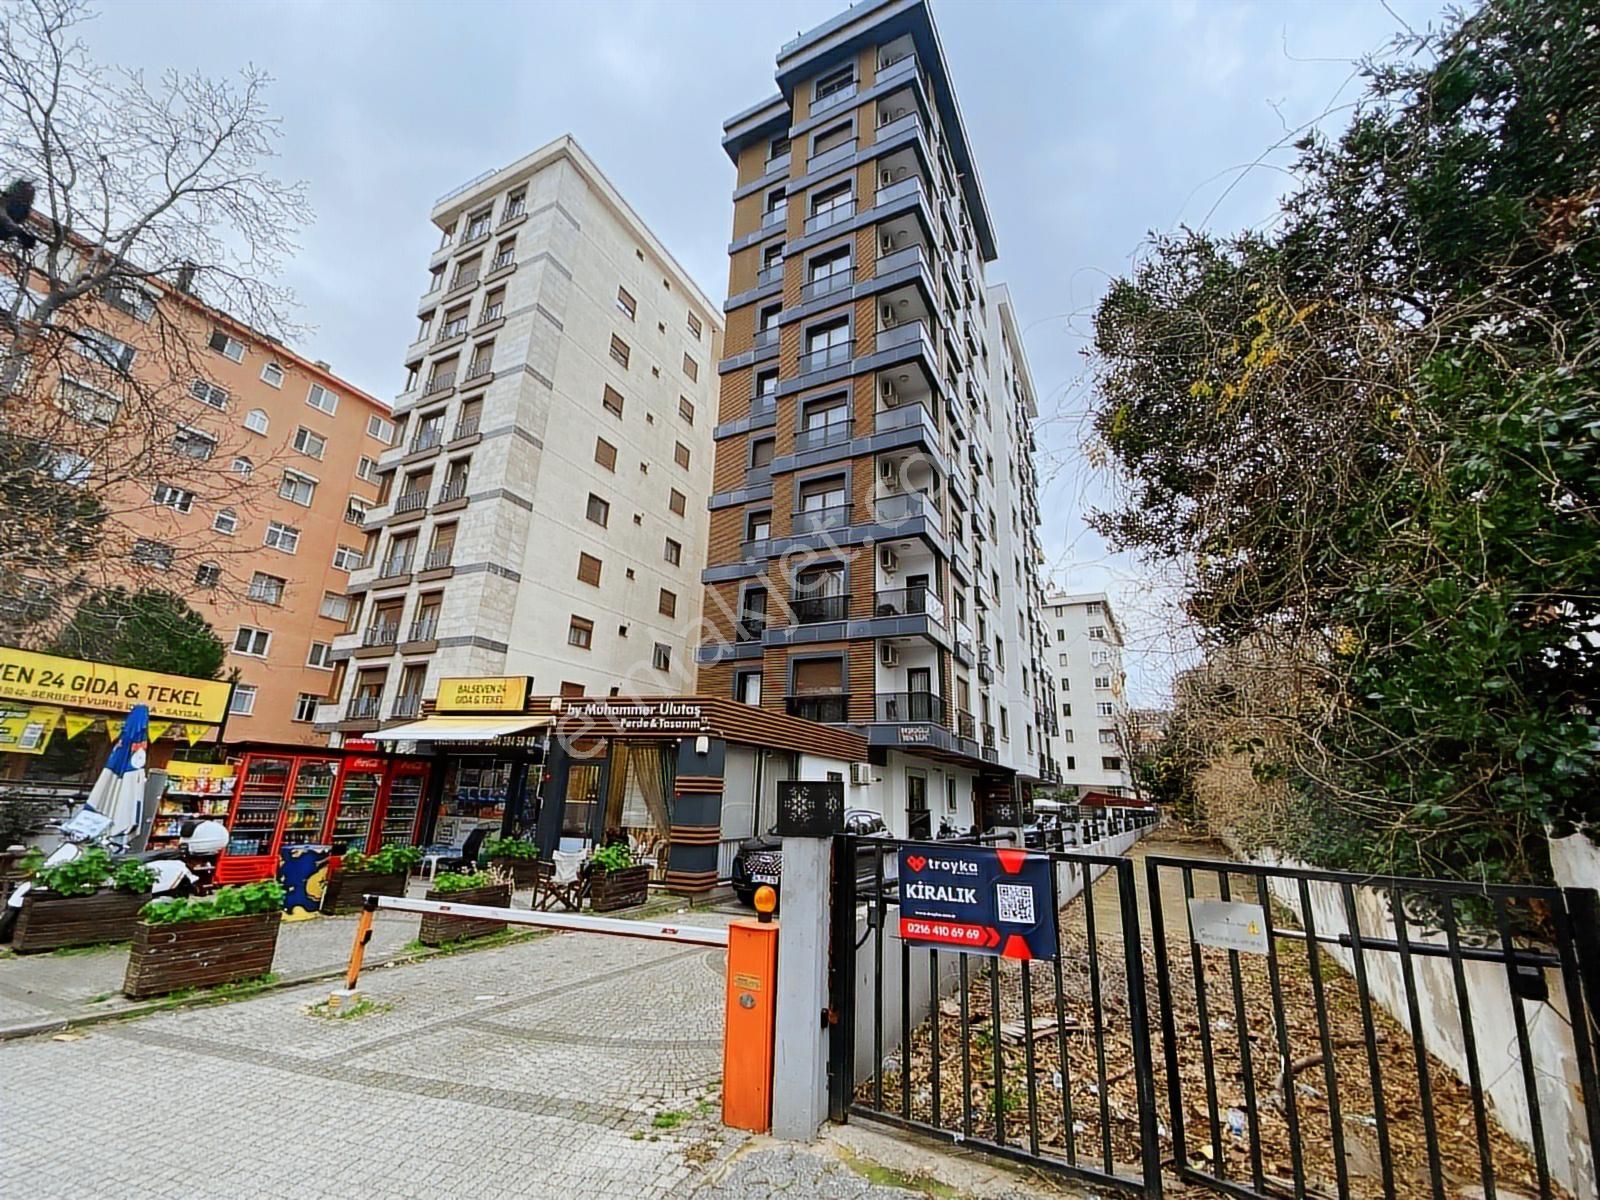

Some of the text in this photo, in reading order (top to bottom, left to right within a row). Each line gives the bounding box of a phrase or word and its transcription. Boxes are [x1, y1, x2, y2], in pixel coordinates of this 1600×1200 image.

[38, 670, 65, 689] 24
[71, 675, 119, 697] GIDA
[124, 682, 140, 699] &
[147, 685, 203, 707] TEKEL
[457, 684, 496, 694] BALSEVEN
[481, 695, 504, 705] TEKEL
[567, 703, 583, 718] by
[659, 701, 702, 718] Ulutaş
[928, 858, 978, 875] troyka
[906, 880, 978, 904] KİRALIK
[907, 922, 980, 940] 0216 410 69 69
